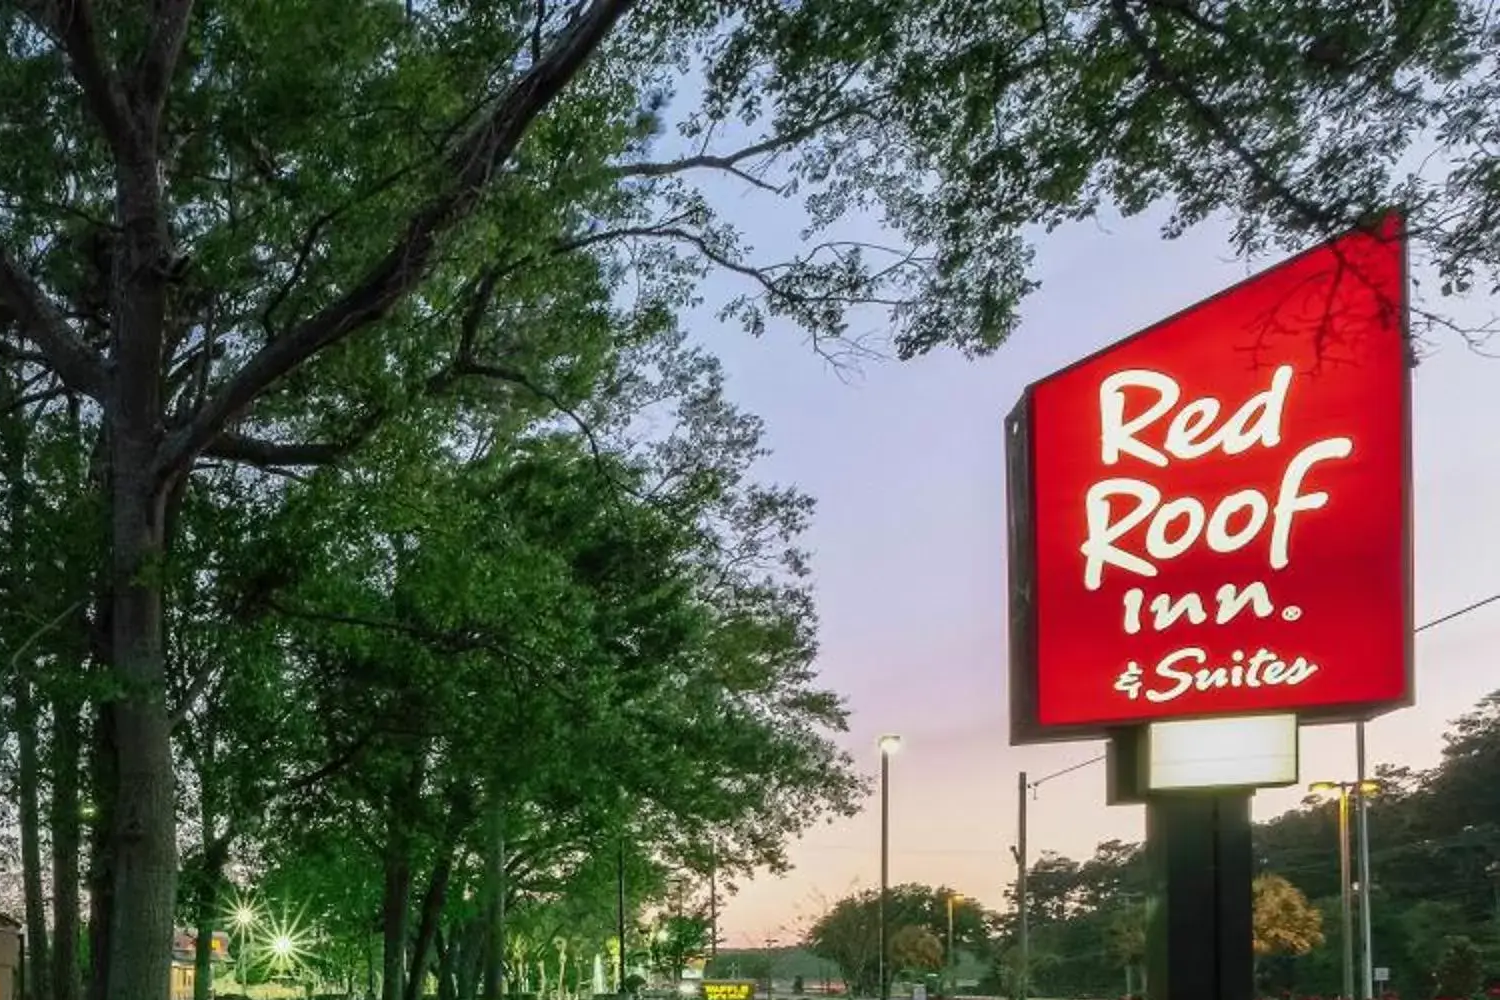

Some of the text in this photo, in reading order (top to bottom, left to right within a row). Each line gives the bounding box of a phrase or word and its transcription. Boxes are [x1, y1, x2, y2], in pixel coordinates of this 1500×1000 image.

[1099, 365, 1294, 467] Red
[1080, 437, 1353, 591] Roof
[1113, 647, 1319, 703] & Suites
